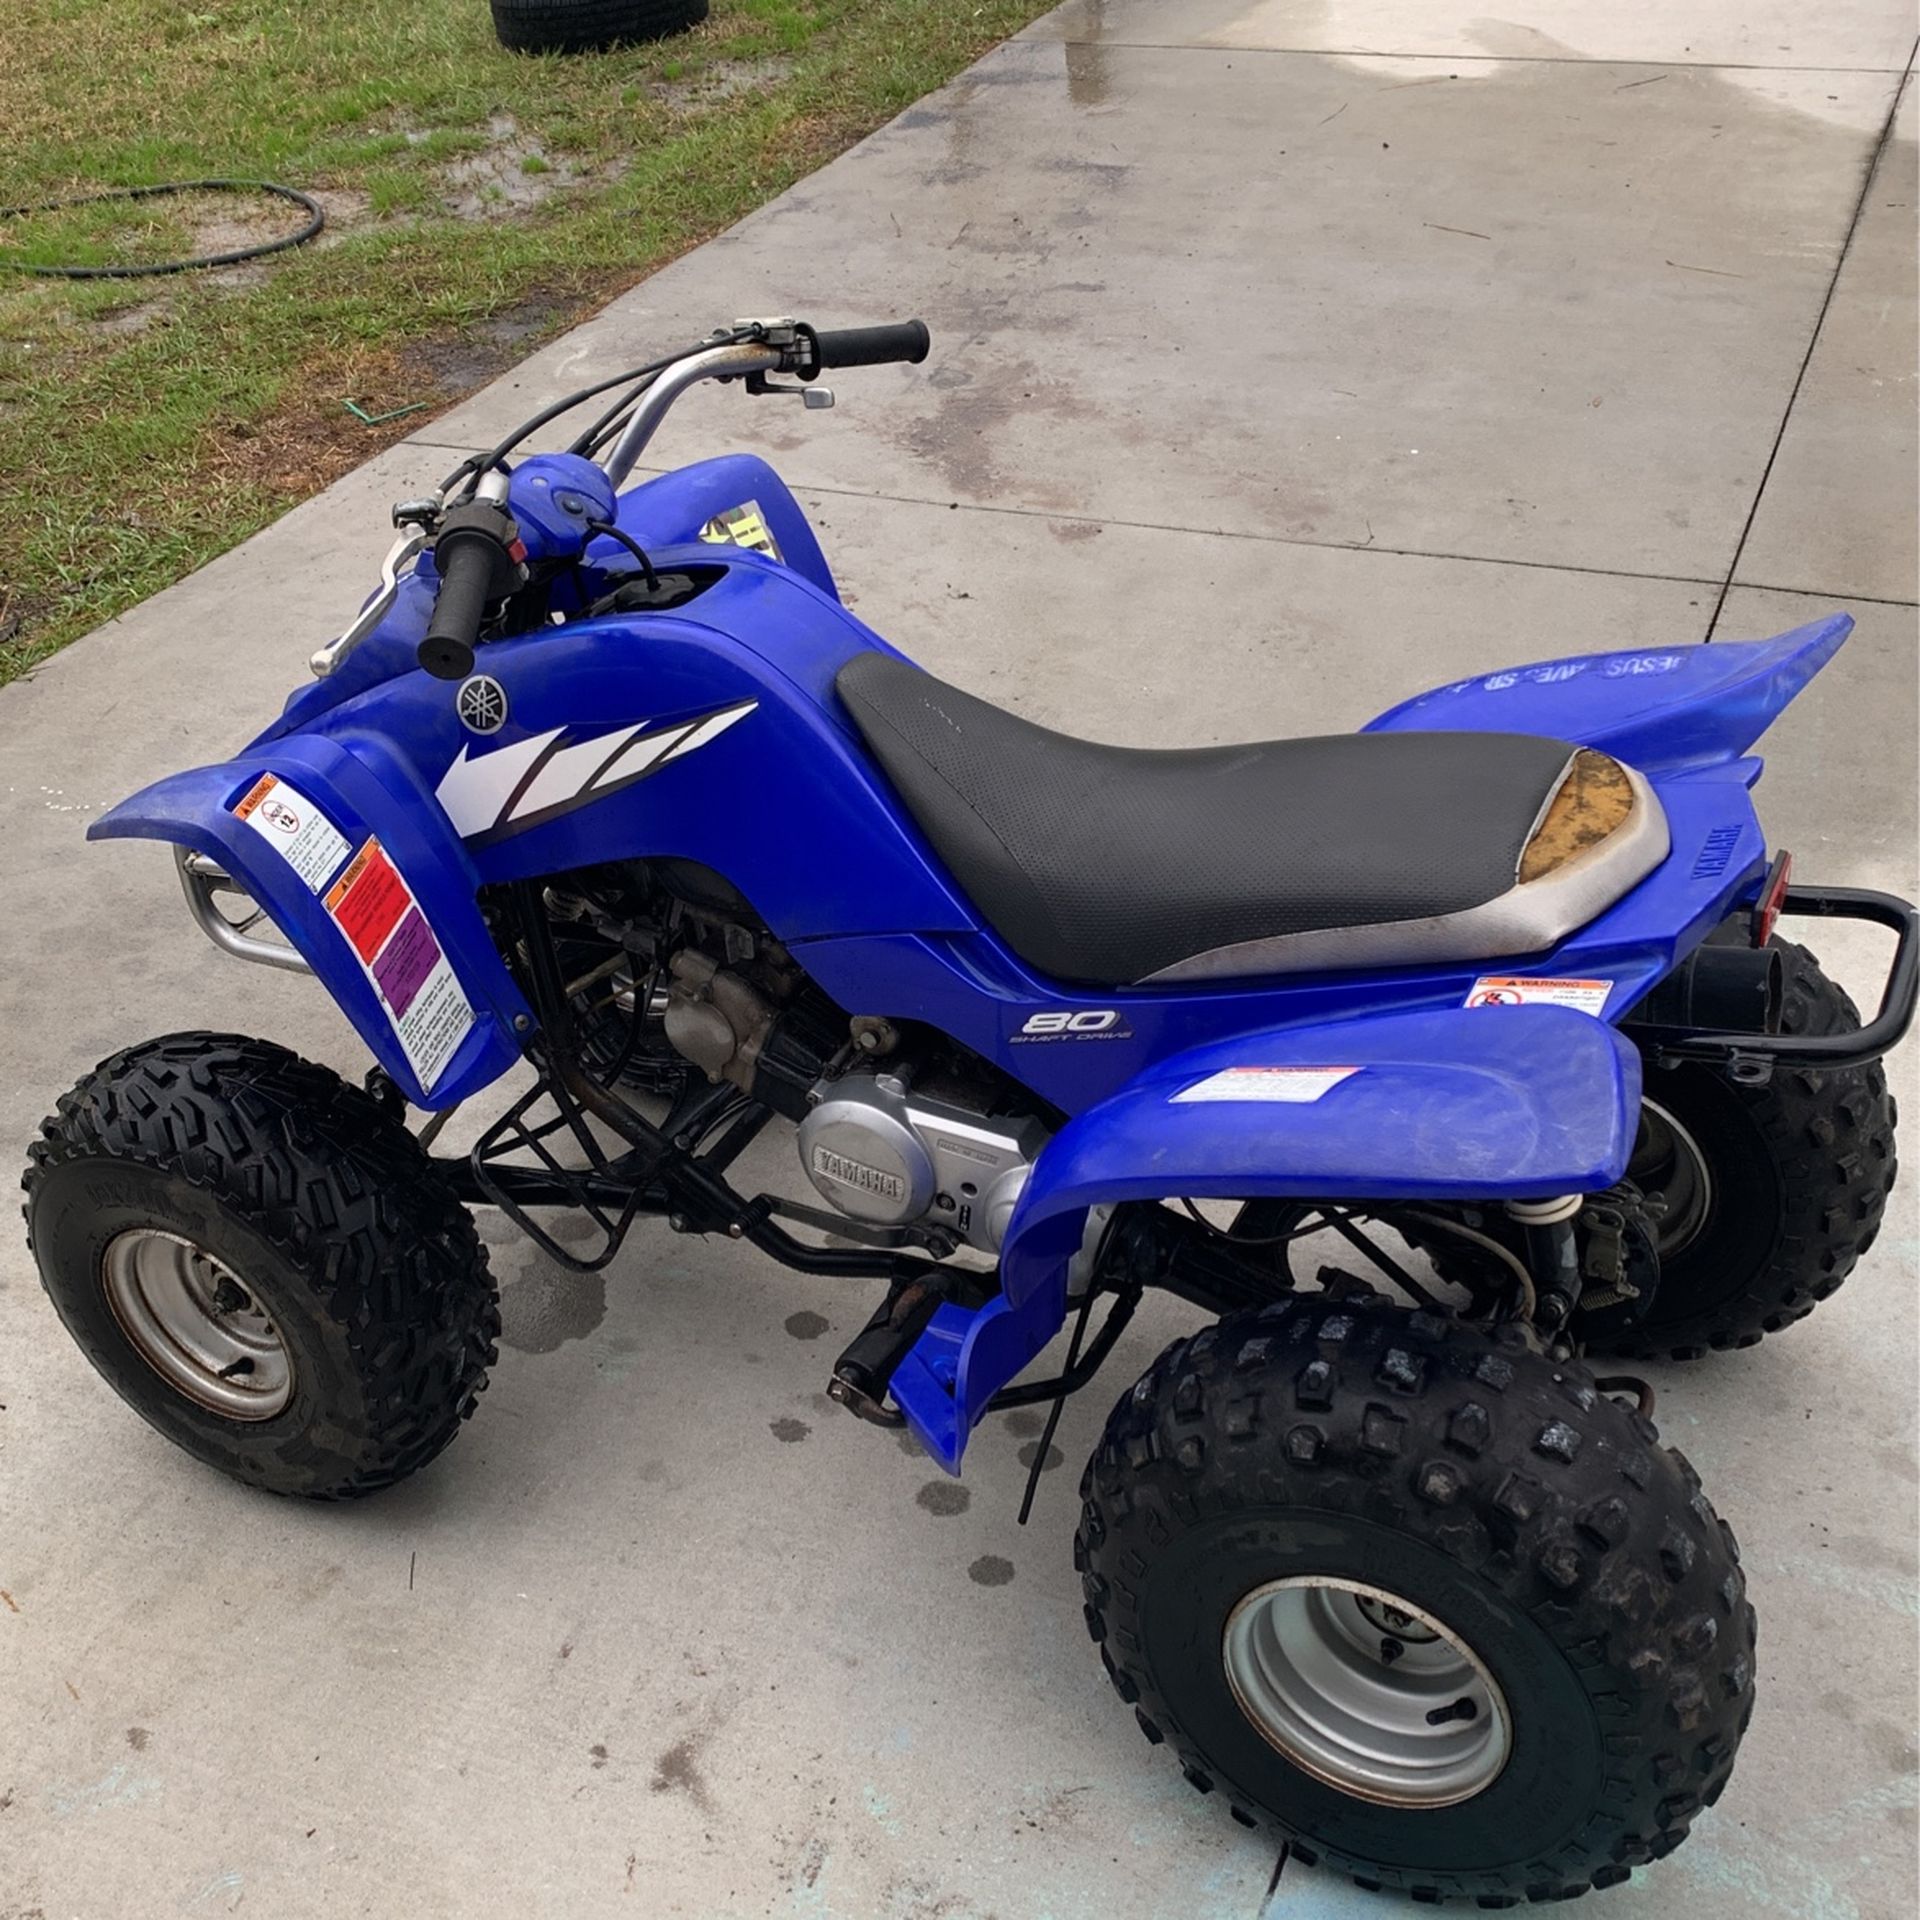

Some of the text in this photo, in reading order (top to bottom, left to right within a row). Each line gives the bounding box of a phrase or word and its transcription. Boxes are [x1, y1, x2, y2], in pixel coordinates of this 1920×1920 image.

[1605, 655, 1687, 677] JESUS
[279, 814, 295, 829] 12
[1690, 823, 1743, 880] YAMAHA
[1520, 980, 1580, 988] WARNING
[1022, 1010, 1118, 1033] 80
[1008, 1030, 1133, 1044] SHAFT DRIVE
[820, 1150, 899, 1197] YAMAHA
